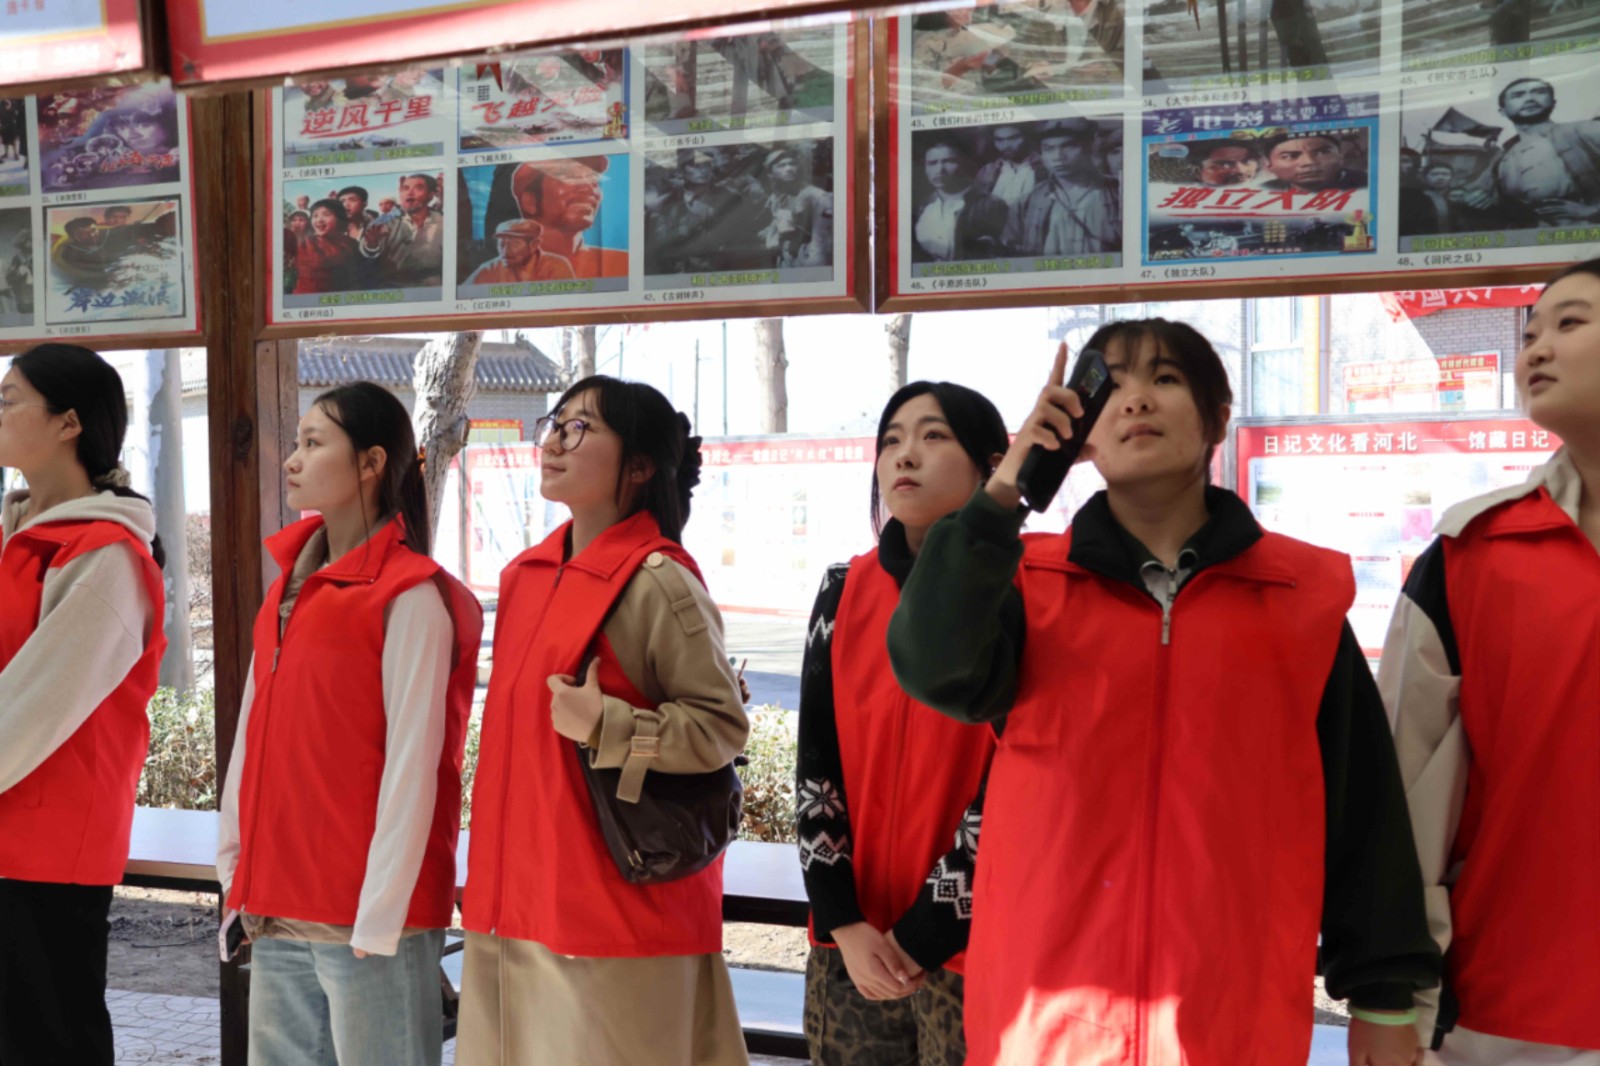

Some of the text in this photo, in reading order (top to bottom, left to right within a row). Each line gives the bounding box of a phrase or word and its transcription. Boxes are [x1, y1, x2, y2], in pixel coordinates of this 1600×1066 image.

[300, 95, 432, 135] 逆风千里
[1157, 187, 1357, 211] 独立大队
